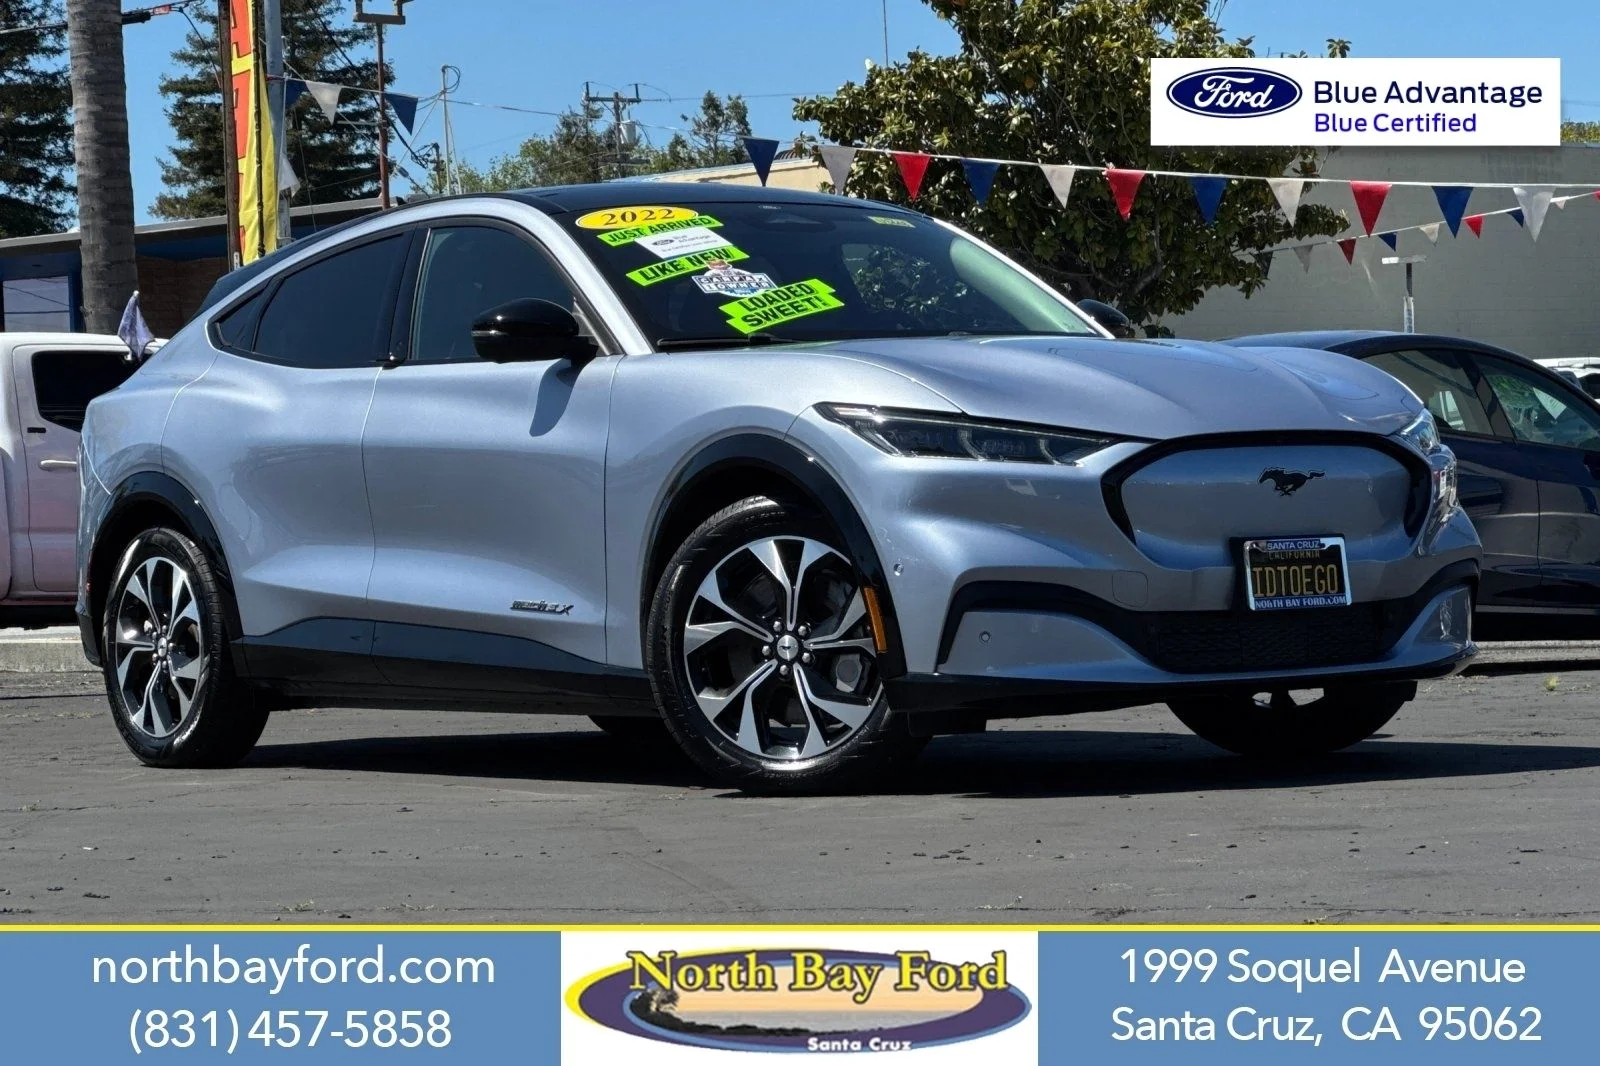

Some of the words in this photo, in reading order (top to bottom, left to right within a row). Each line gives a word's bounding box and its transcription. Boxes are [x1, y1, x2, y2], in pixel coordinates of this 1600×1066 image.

[600, 208, 676, 226] 2022
[608, 228, 646, 243] JUST
[648, 217, 713, 234] ARRIVED
[638, 259, 686, 281] LIKE
[685, 248, 732, 267] NEW
[700, 274, 770, 283] CARFAX
[737, 283, 817, 312] LOADED
[741, 295, 828, 327] SWEET!
[1267, 541, 1296, 550] SANTA
[1297, 540, 1320, 549] CRUZ
[1269, 551, 1320, 560] CALIFORNIA
[1255, 599, 1284, 609] NORTH
[1286, 599, 1301, 608] BAY
[1303, 596, 1346, 606] FORD.COM
